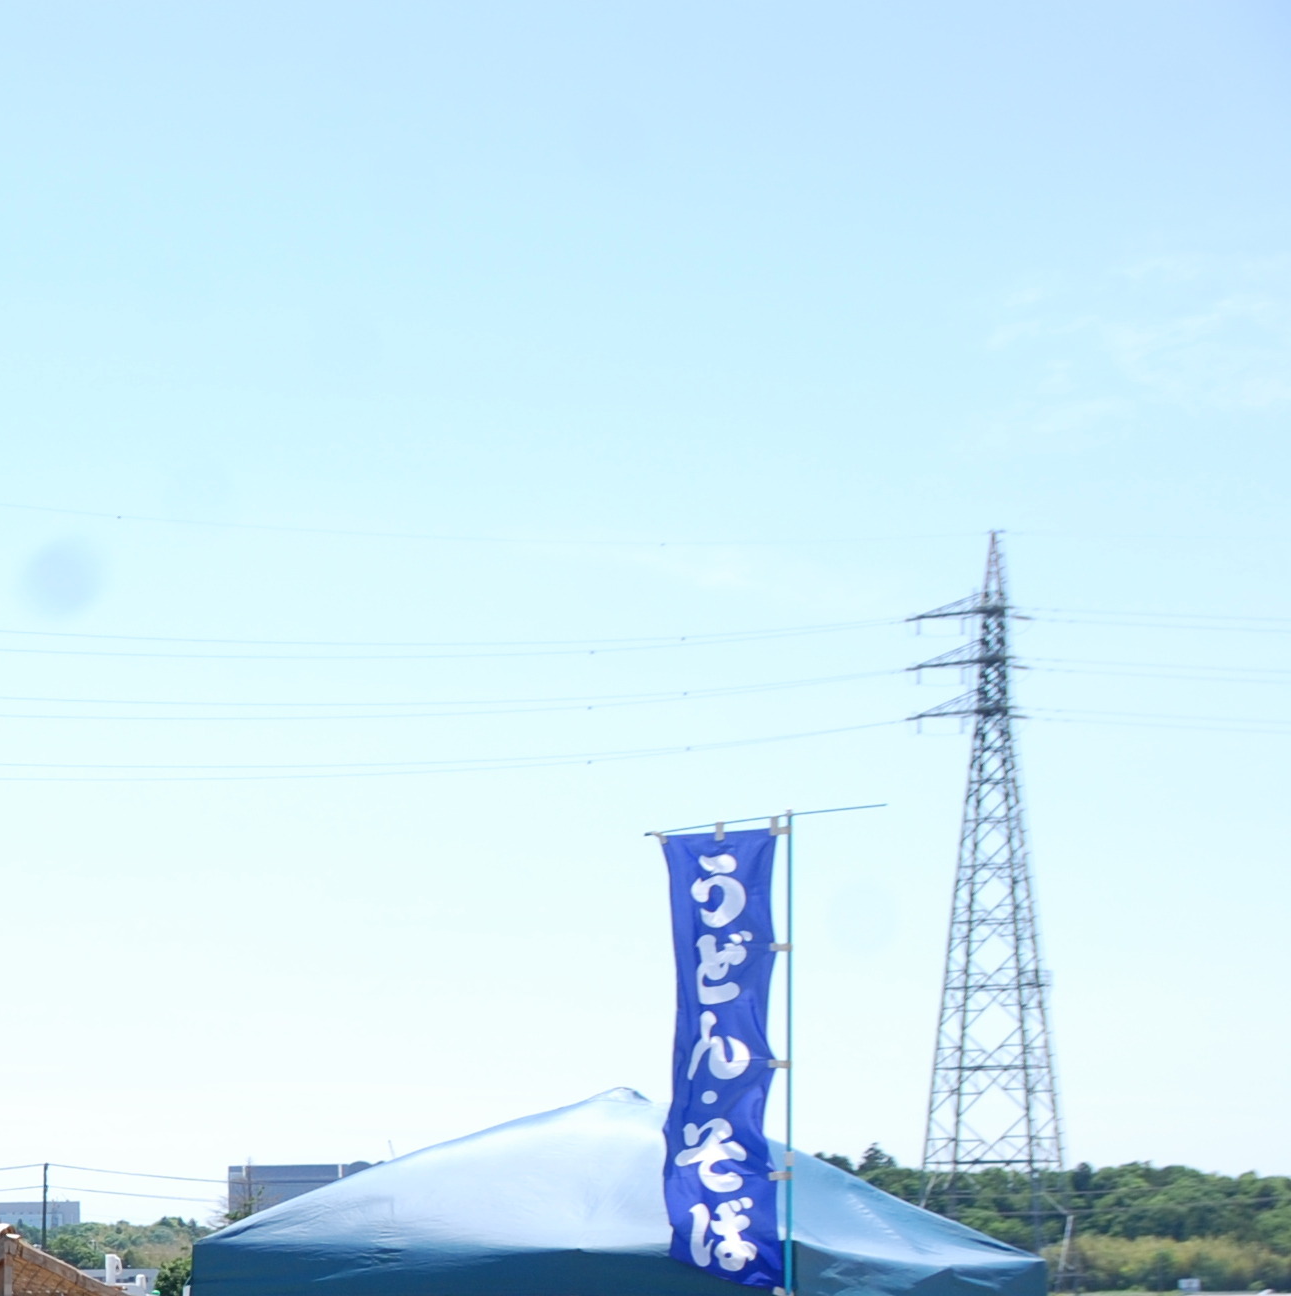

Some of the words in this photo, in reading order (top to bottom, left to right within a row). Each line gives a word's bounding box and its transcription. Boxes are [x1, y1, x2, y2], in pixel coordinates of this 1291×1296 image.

[674, 853, 758, 1272] うどん・そば
